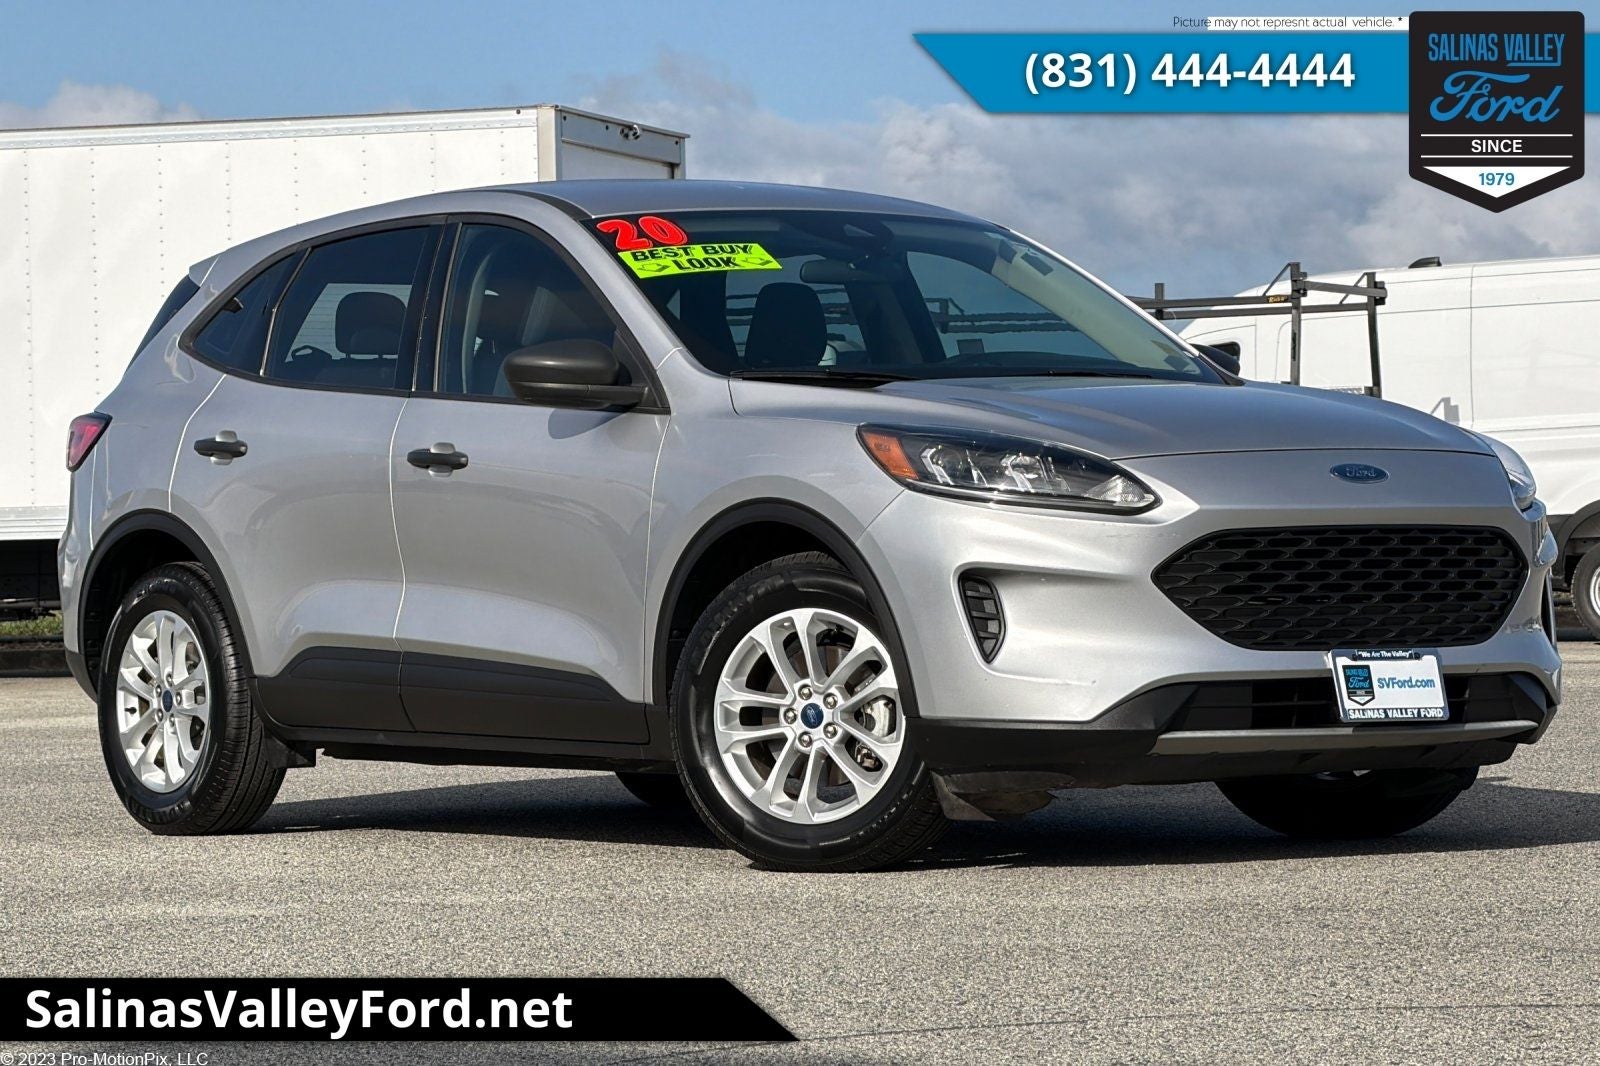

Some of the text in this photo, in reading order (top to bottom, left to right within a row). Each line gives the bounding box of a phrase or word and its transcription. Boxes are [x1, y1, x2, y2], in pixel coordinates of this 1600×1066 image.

[596, 215, 689, 251] 20
[631, 244, 754, 261] BEST BUY
[672, 256, 740, 271] LOOK
[1377, 677, 1436, 689] SVFord.com
[1349, 708, 1444, 719] SALINAS VALLEY FORD
